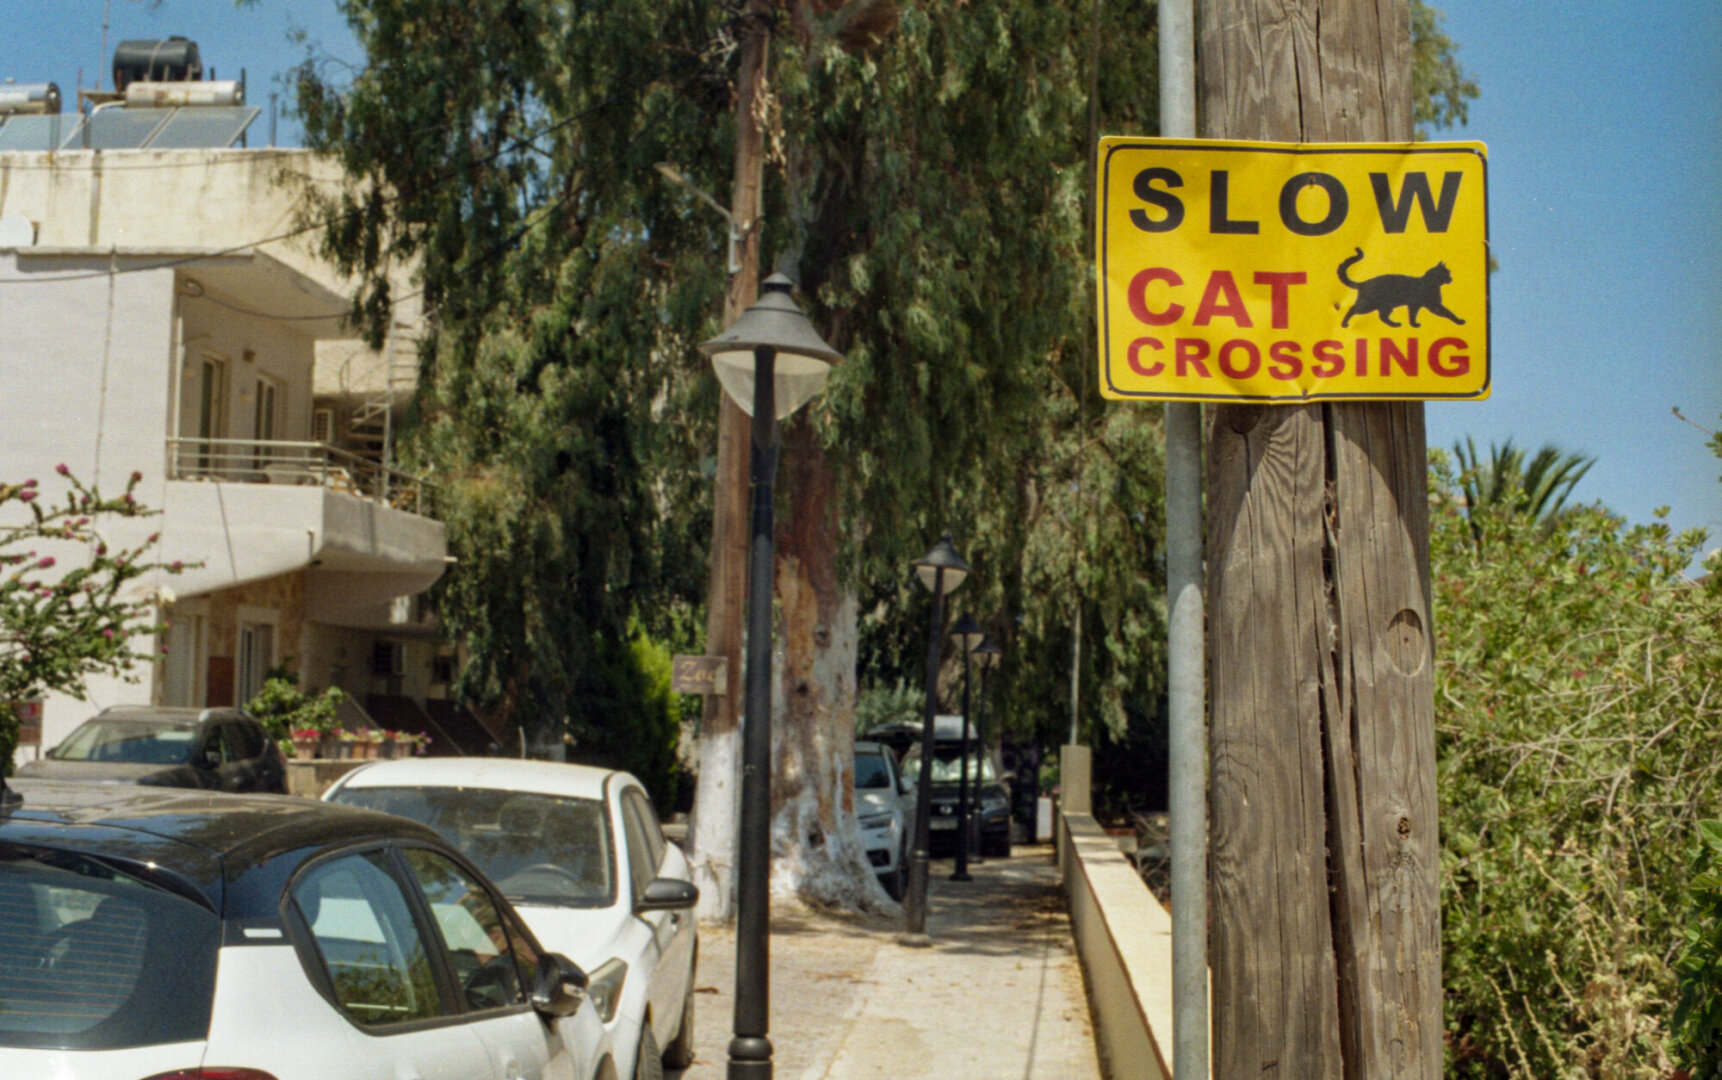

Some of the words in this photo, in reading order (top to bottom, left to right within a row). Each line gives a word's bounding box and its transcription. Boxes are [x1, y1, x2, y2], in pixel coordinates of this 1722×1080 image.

[1129, 167, 1462, 236] SLOW
[1128, 268, 1307, 330] CAT
[1128, 337, 1470, 380] CROSSING
